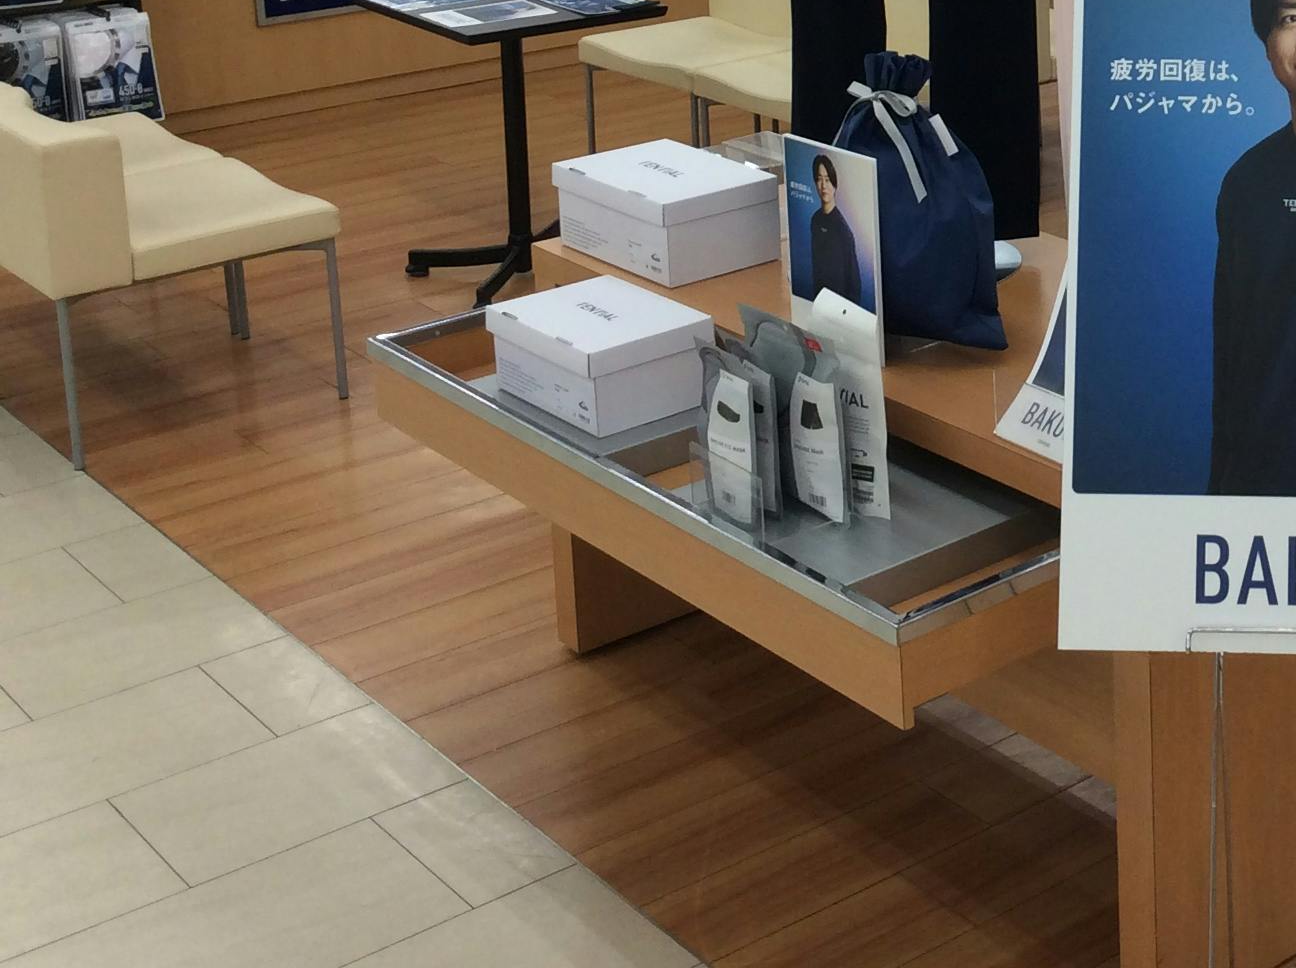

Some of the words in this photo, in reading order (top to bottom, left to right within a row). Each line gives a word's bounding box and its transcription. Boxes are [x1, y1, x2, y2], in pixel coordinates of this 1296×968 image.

[1110, 57, 1239, 82] 疲労回復は、
[1109, 91, 1255, 116] パジャマから。
[638, 160, 685, 179] TENTIAL
[576, 301, 619, 322] TENTIAL
[1021, 401, 1065, 438] BAKU
